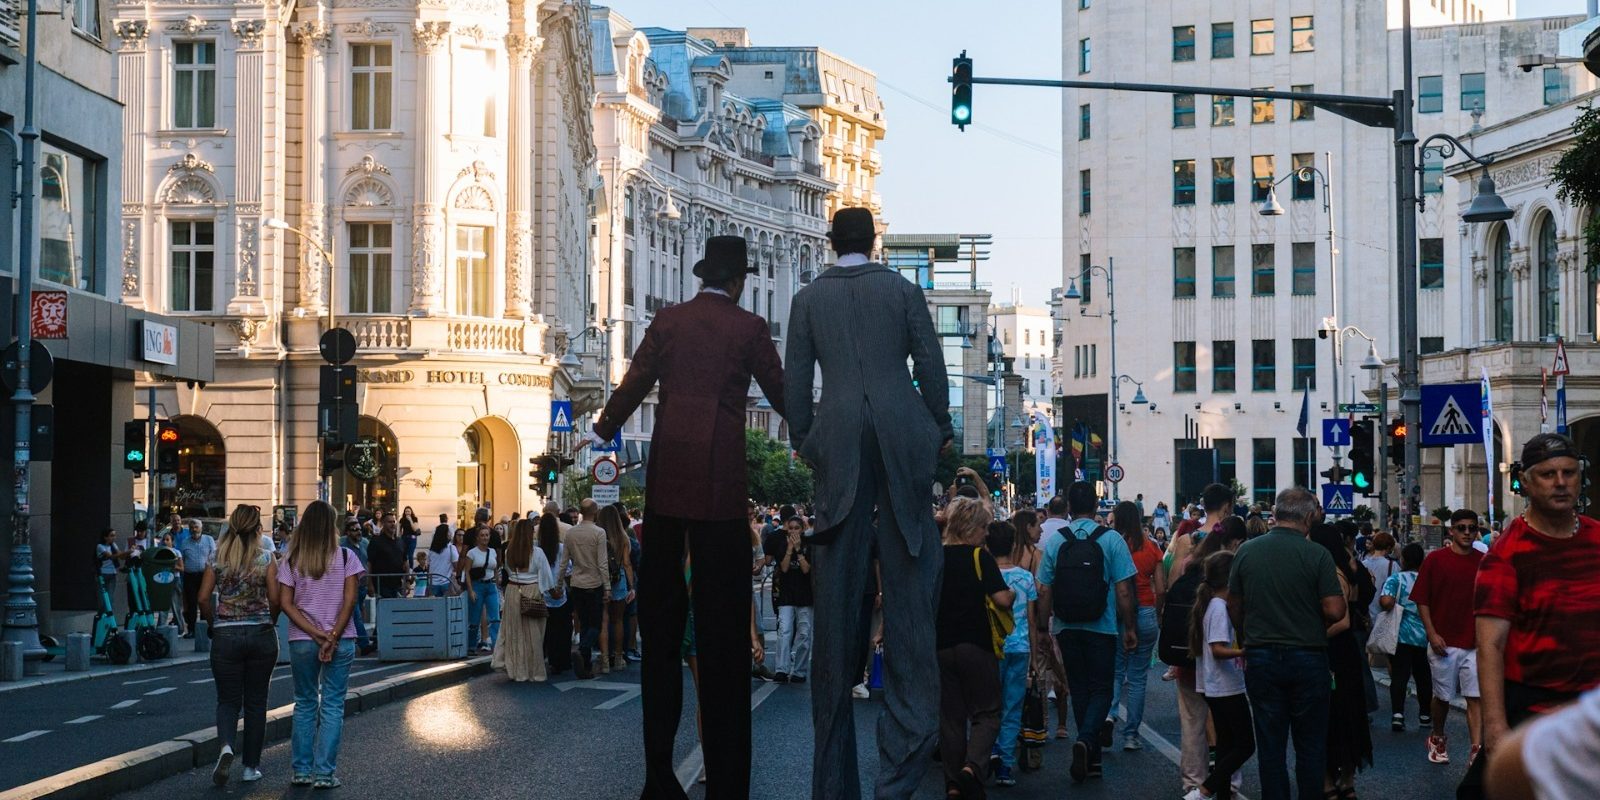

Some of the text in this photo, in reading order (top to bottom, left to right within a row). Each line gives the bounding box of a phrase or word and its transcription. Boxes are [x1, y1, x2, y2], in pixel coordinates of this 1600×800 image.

[145, 329, 162, 354] ING
[426, 370, 490, 384] HOTEL
[1110, 469, 1120, 478] 30
